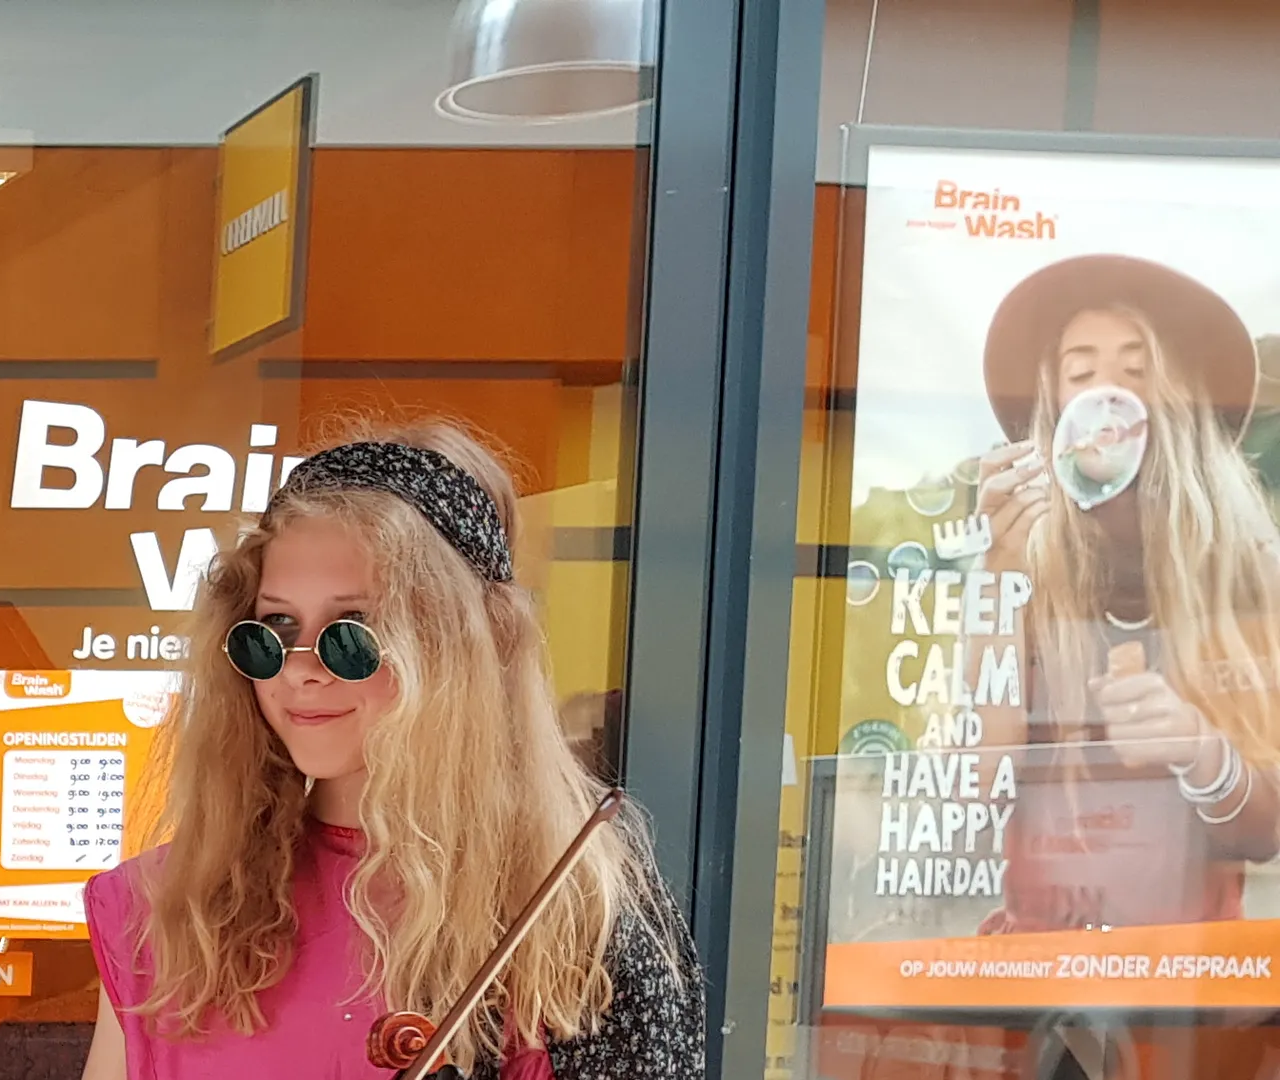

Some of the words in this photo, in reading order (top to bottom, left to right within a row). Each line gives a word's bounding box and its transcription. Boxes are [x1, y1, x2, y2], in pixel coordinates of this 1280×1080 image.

[935, 179, 1020, 211] Brain
[964, 211, 1056, 240] Wash
[891, 567, 1032, 636] KEEP
[72, 626, 116, 660] Je
[11, 673, 48, 686] Brain
[24, 683, 63, 696] Wash
[886, 639, 1021, 707] CALM
[921, 712, 982, 747] AND
[881, 752, 980, 799] HAVE
[989, 754, 1017, 799] A
[878, 801, 1017, 853] HAPPY
[874, 857, 1010, 897] HAIRDAY
[899, 959, 922, 978] OP
[925, 959, 977, 978] JOUW
[978, 959, 1052, 978] MOMENT
[1055, 955, 1151, 979] ZONDER
[1154, 955, 1272, 979] AFSPRAAK
